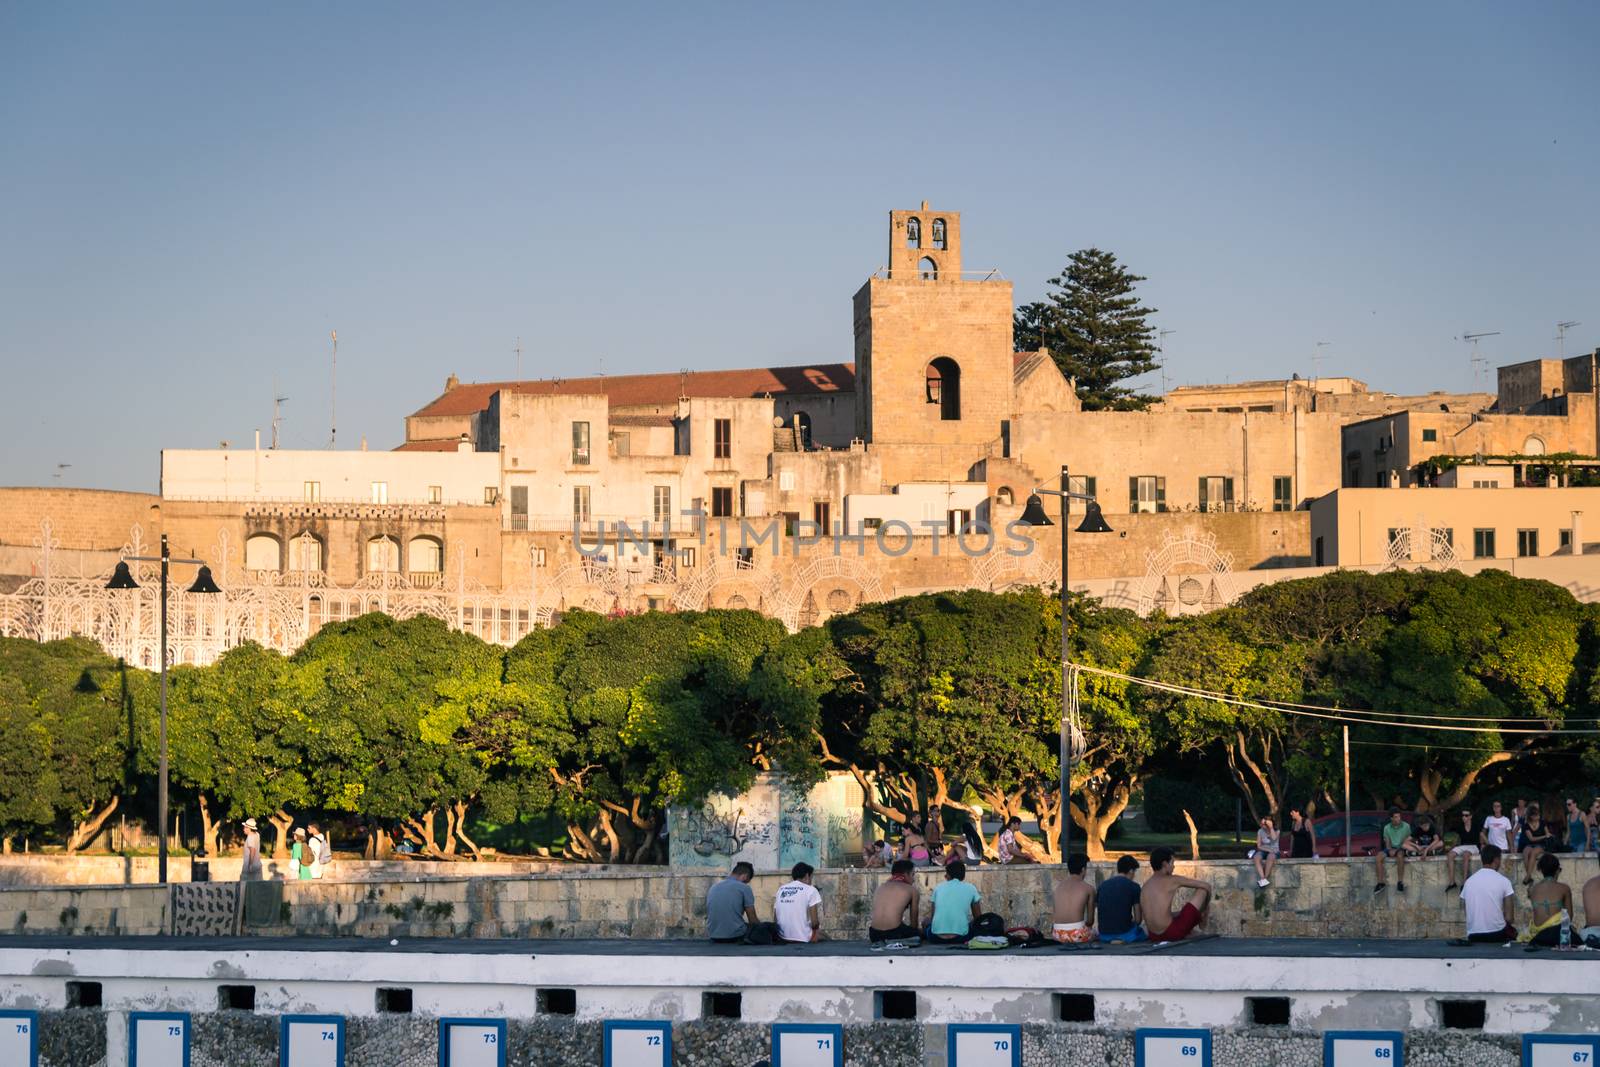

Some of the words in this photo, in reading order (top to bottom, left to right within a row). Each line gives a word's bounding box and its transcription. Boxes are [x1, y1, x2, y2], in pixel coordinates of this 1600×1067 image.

[16, 1024, 29, 1034] 76
[168, 1026, 181, 1036] 75
[321, 1031, 335, 1041] 74
[484, 1033, 497, 1044] 73
[646, 1035, 661, 1046] 72
[817, 1039, 830, 1050] 71
[994, 1040, 1009, 1051] 70
[1181, 1045, 1197, 1057] 69
[1375, 1047, 1391, 1058] 68
[1572, 1051, 1590, 1062] 67
